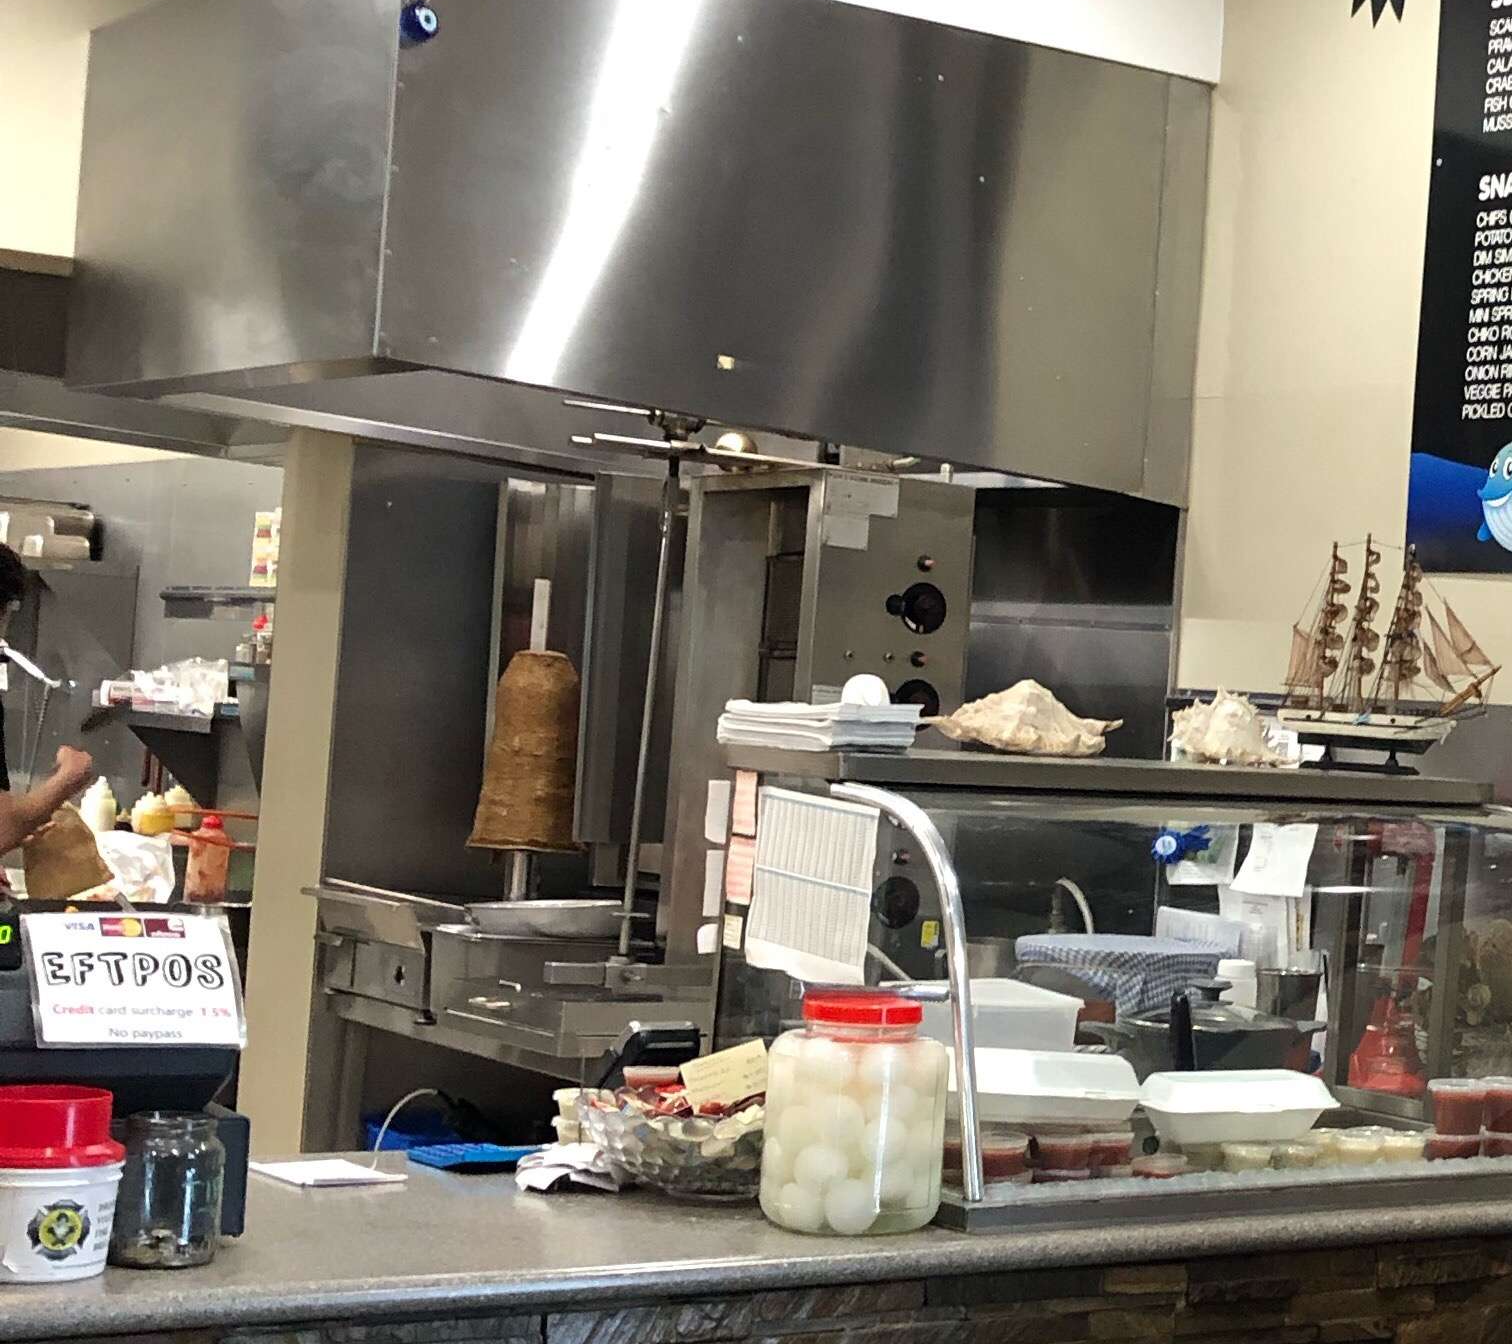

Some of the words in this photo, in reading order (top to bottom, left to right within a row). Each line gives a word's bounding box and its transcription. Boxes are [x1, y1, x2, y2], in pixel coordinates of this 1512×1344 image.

[1484, 96, 1506, 114] FISH
[1474, 228, 1512, 246] POTATO
[1464, 383, 1500, 400] VEGGIE
[1462, 403, 1505, 419] PICKLED
[42, 952, 224, 989] EFTPOS
[53, 1004, 95, 1015] Credit
[109, 1028, 128, 1037] No
